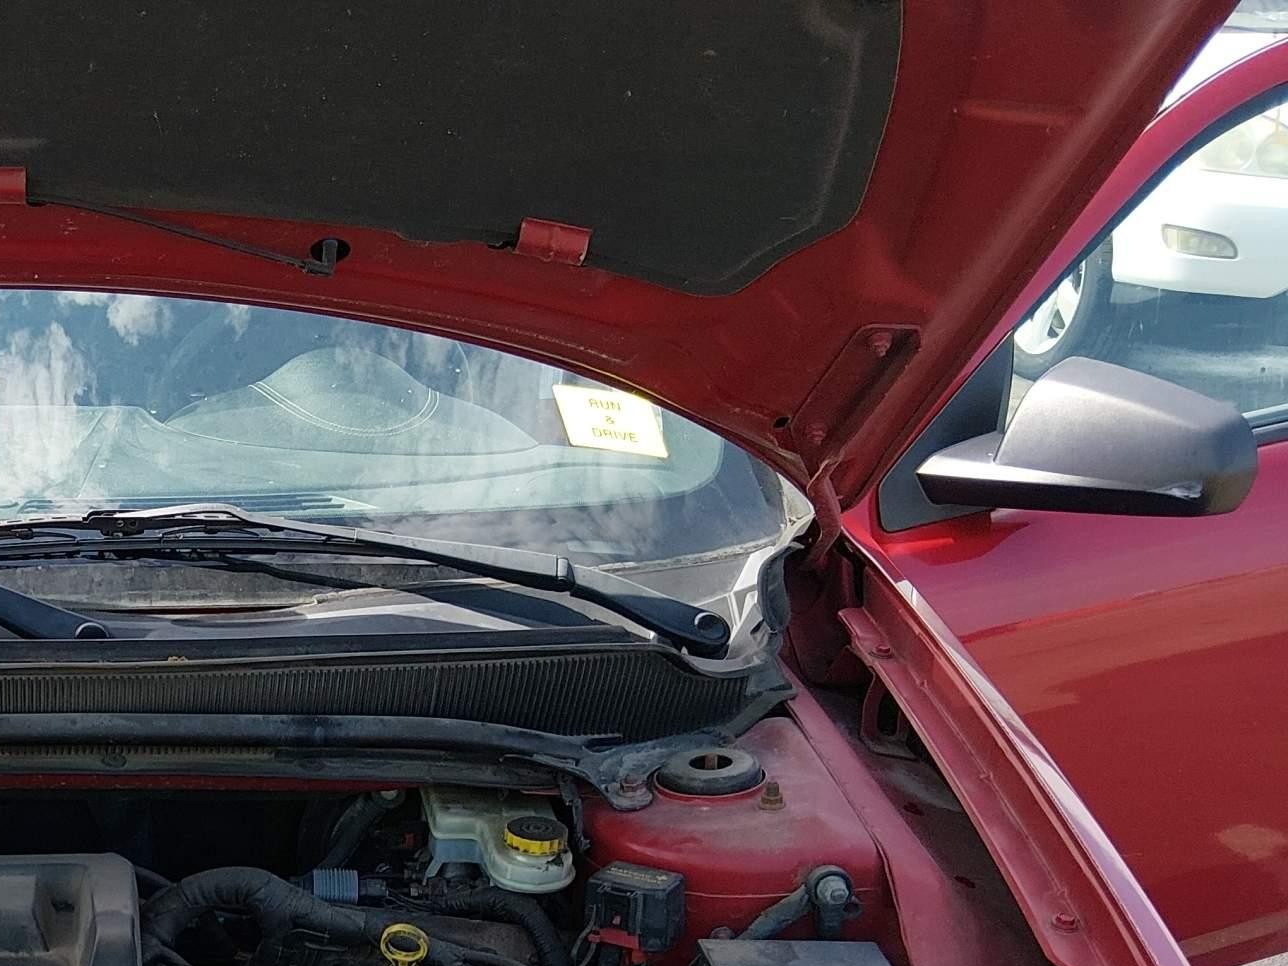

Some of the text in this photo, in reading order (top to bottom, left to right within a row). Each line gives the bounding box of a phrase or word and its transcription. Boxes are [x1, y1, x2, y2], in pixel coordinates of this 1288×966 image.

[588, 398, 622, 411] RUN
[605, 416, 616, 425] &
[591, 427, 639, 443] DRIVE
